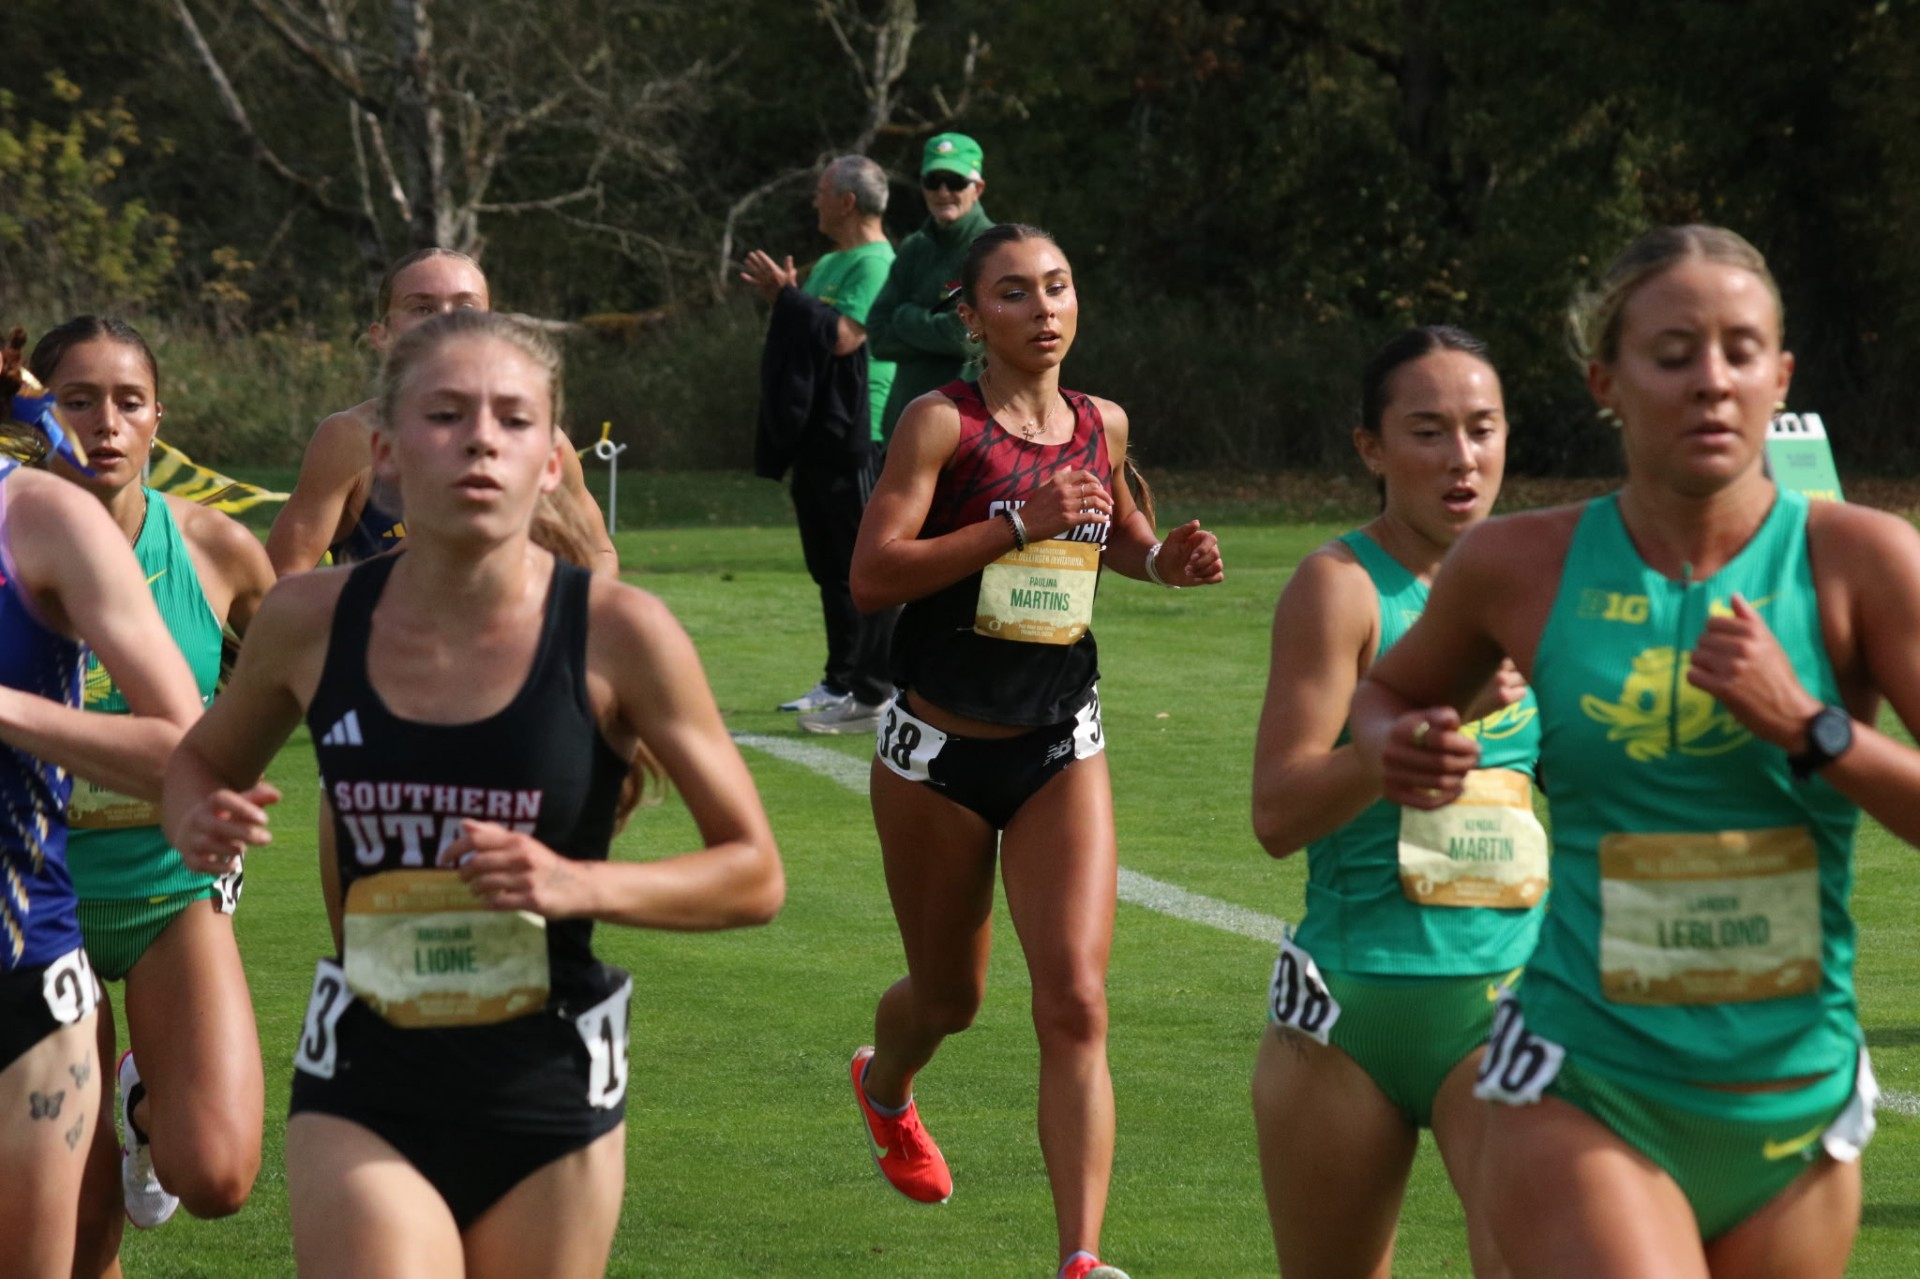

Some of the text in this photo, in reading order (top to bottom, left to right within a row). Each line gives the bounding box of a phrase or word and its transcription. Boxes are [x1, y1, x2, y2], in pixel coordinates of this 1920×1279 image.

[1029, 577, 1057, 588] PAULINA
[1010, 588, 1070, 612] MARTINS
[879, 707, 922, 771] 38
[335, 780, 543, 818] SOUTHERN
[1450, 836, 1514, 862] MARTIN
[1657, 914, 1771, 950] LEBLOND
[415, 946, 480, 976] LIONE
[304, 976, 340, 1062] 3
